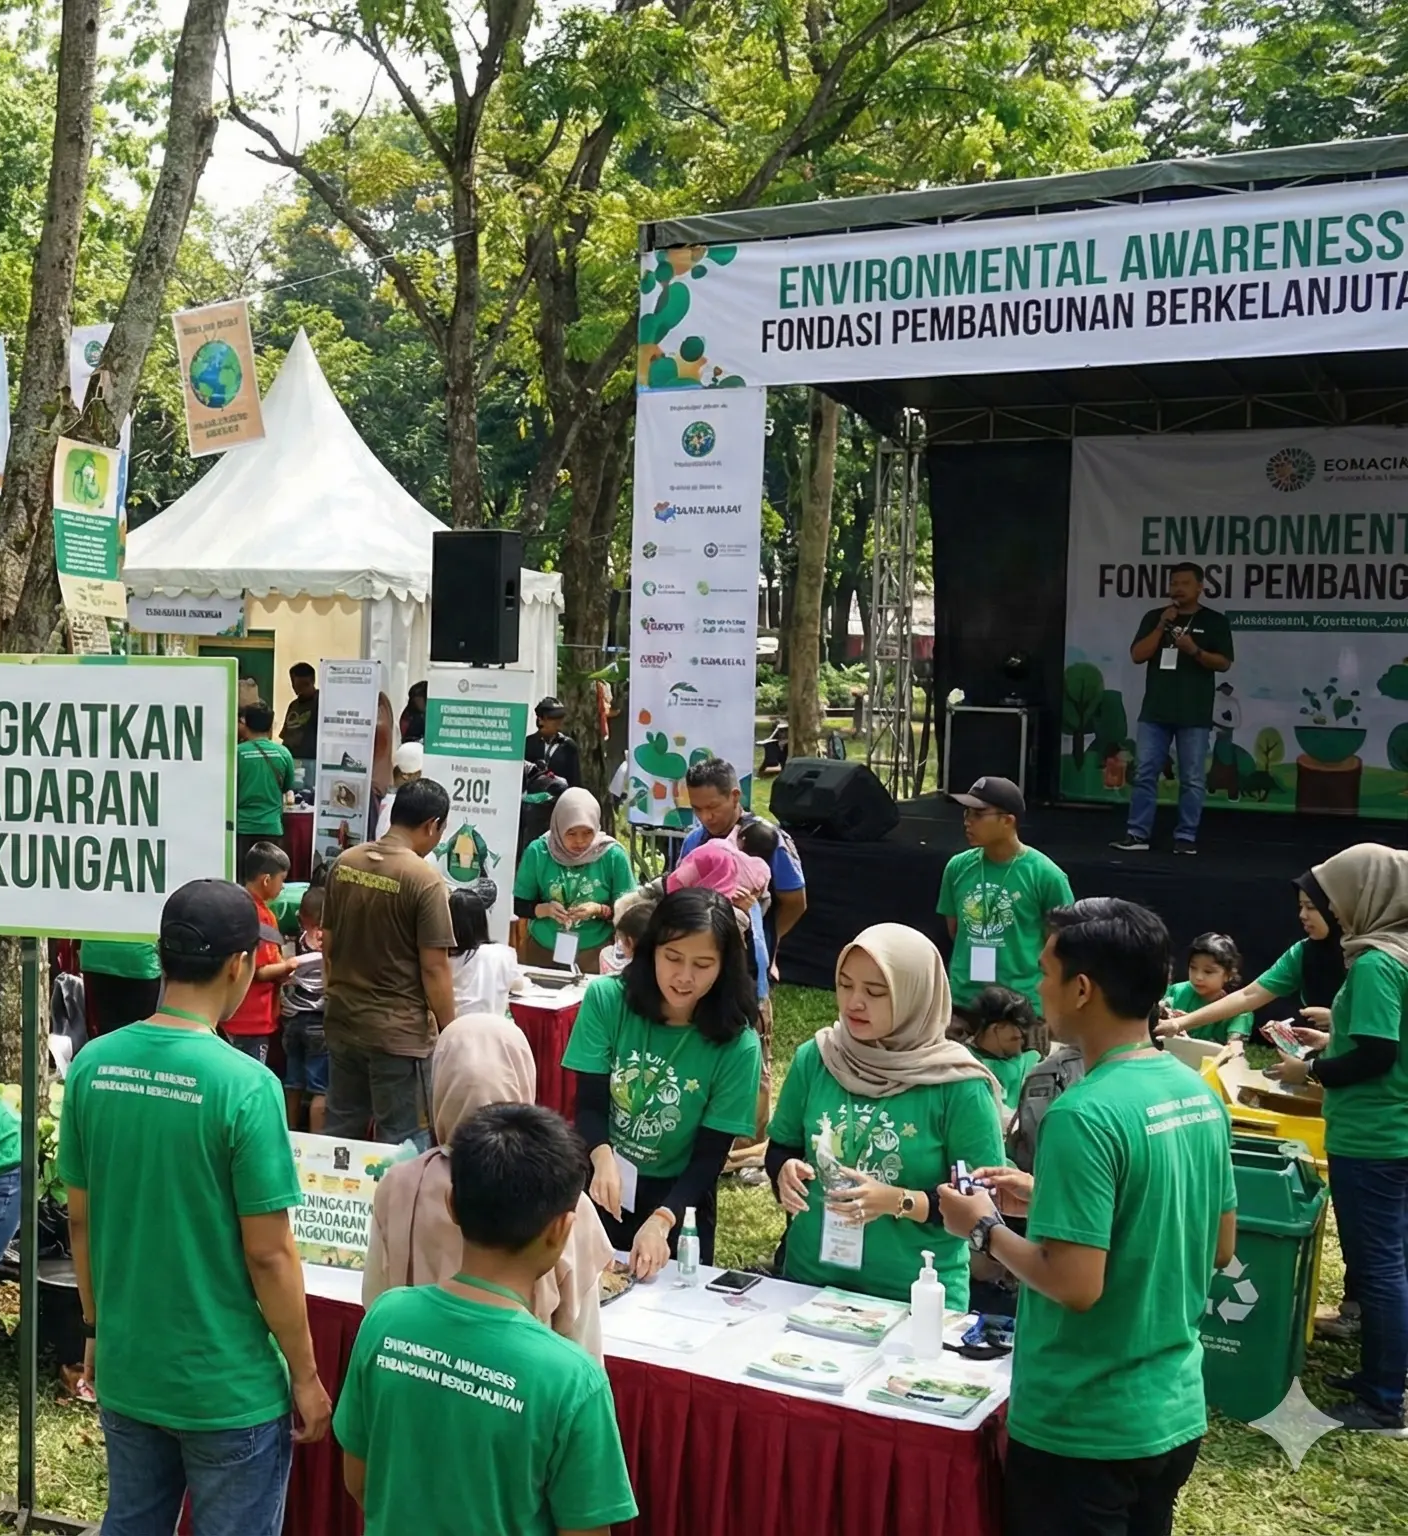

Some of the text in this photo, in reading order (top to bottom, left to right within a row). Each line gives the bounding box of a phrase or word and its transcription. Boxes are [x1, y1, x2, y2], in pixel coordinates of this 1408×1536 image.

[779, 210, 1405, 310] ENVIRONMENTAL AWARENESS
[761, 311, 883, 353] FONDASI
[891, 289, 1135, 345] PEMBANGUNAN
[1098, 564, 1233, 599] FONDSI
